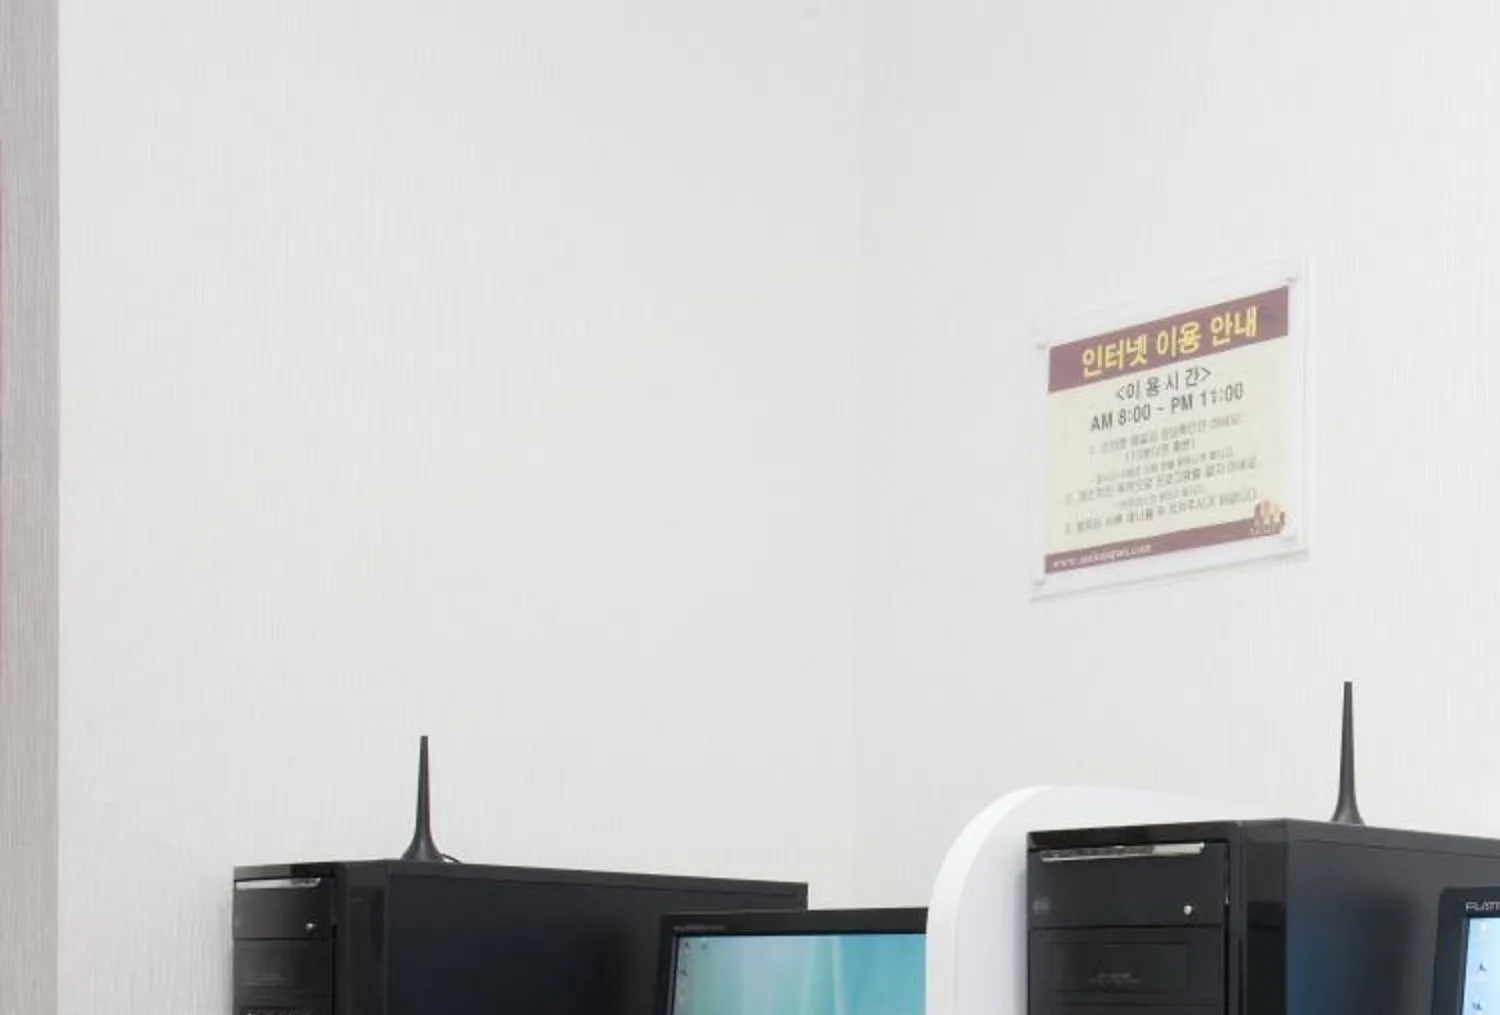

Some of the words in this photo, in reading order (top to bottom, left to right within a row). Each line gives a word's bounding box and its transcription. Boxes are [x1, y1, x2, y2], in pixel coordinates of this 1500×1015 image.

[1082, 334, 1147, 377] 인터넷
[1157, 321, 1201, 357] 이용
[1210, 305, 1258, 346] 안내
[1091, 411, 1113, 430] AM
[1118, 403, 1151, 426] 8:00
[1171, 393, 1193, 414] PM
[1199, 381, 1244, 407] 11:00
